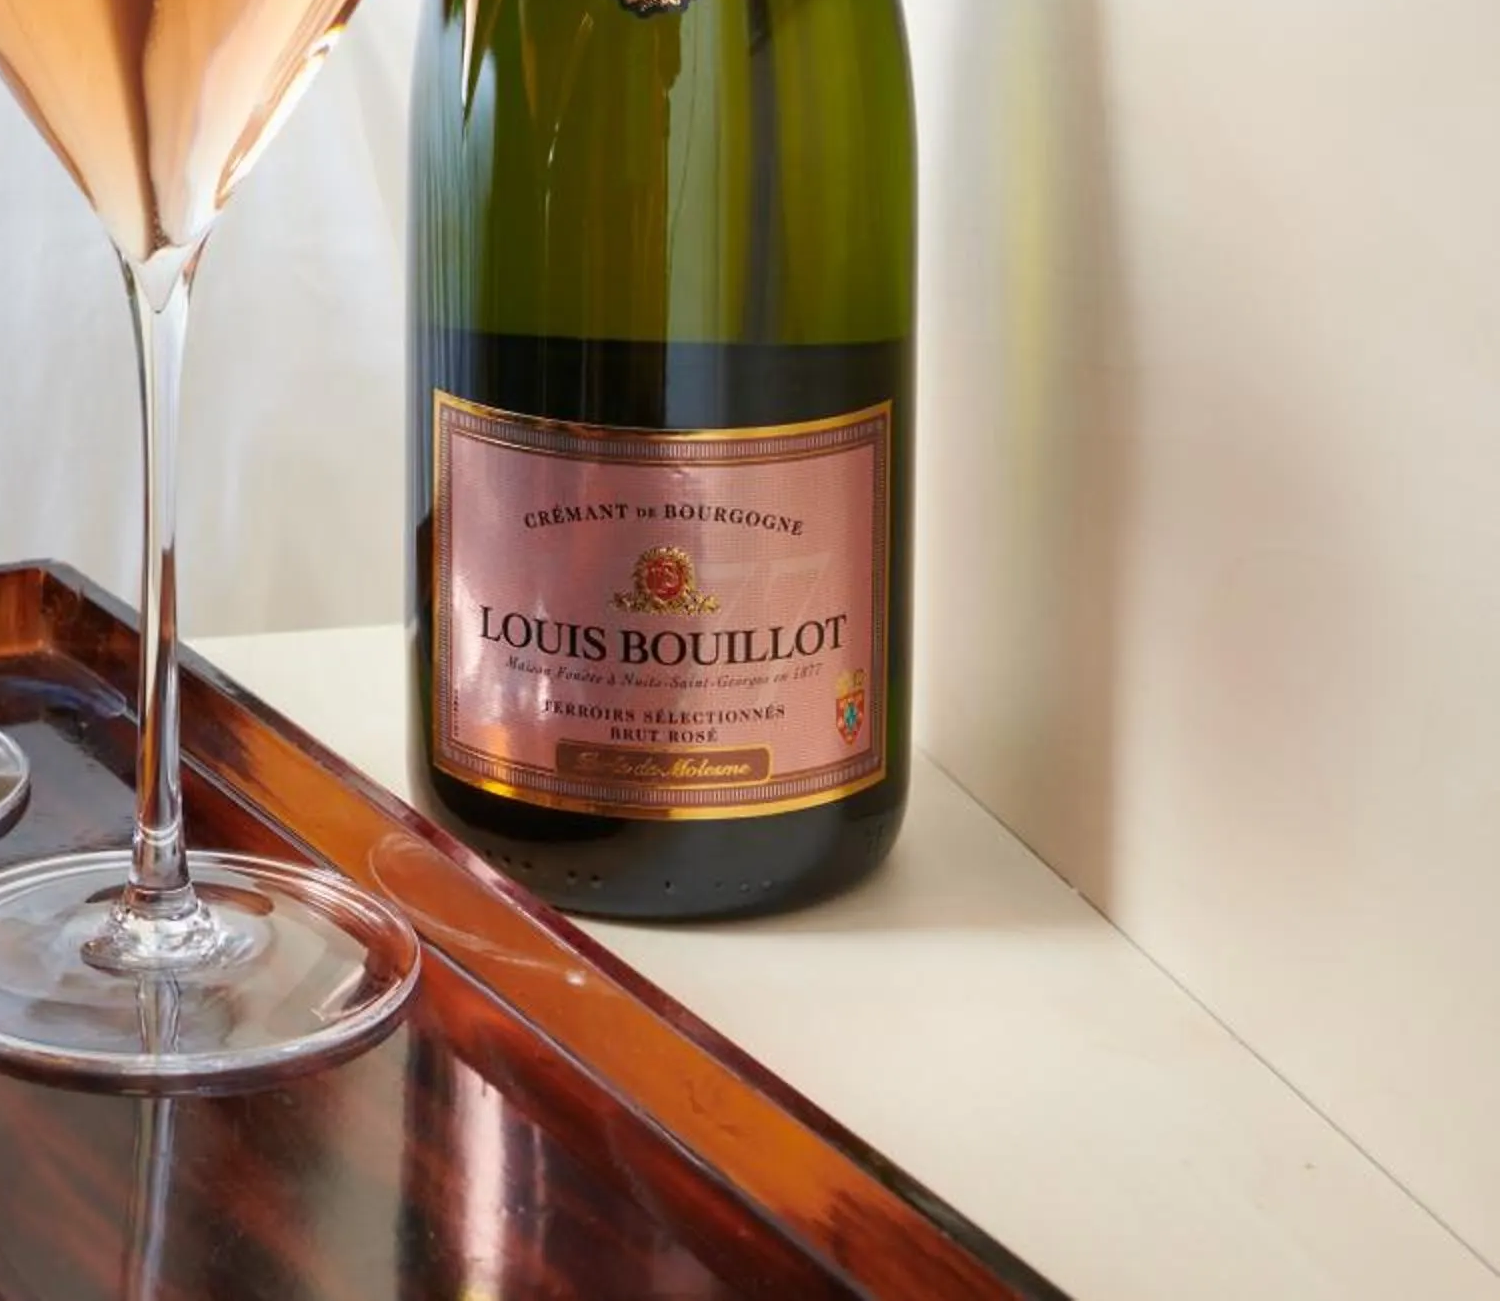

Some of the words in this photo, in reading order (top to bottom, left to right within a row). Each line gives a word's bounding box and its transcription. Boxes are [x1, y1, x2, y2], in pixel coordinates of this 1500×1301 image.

[524, 502, 628, 529] CRÉMANT
[664, 503, 804, 536] BOURGOGNE
[480, 604, 607, 662] LOUIS
[620, 613, 847, 666] BOUILLOT
[544, 700, 635, 722] TERROIRS
[643, 703, 785, 725] SÉLECTIONNÉS
[610, 727, 659, 742] BRUT
[669, 727, 717, 743] ROSÉ
